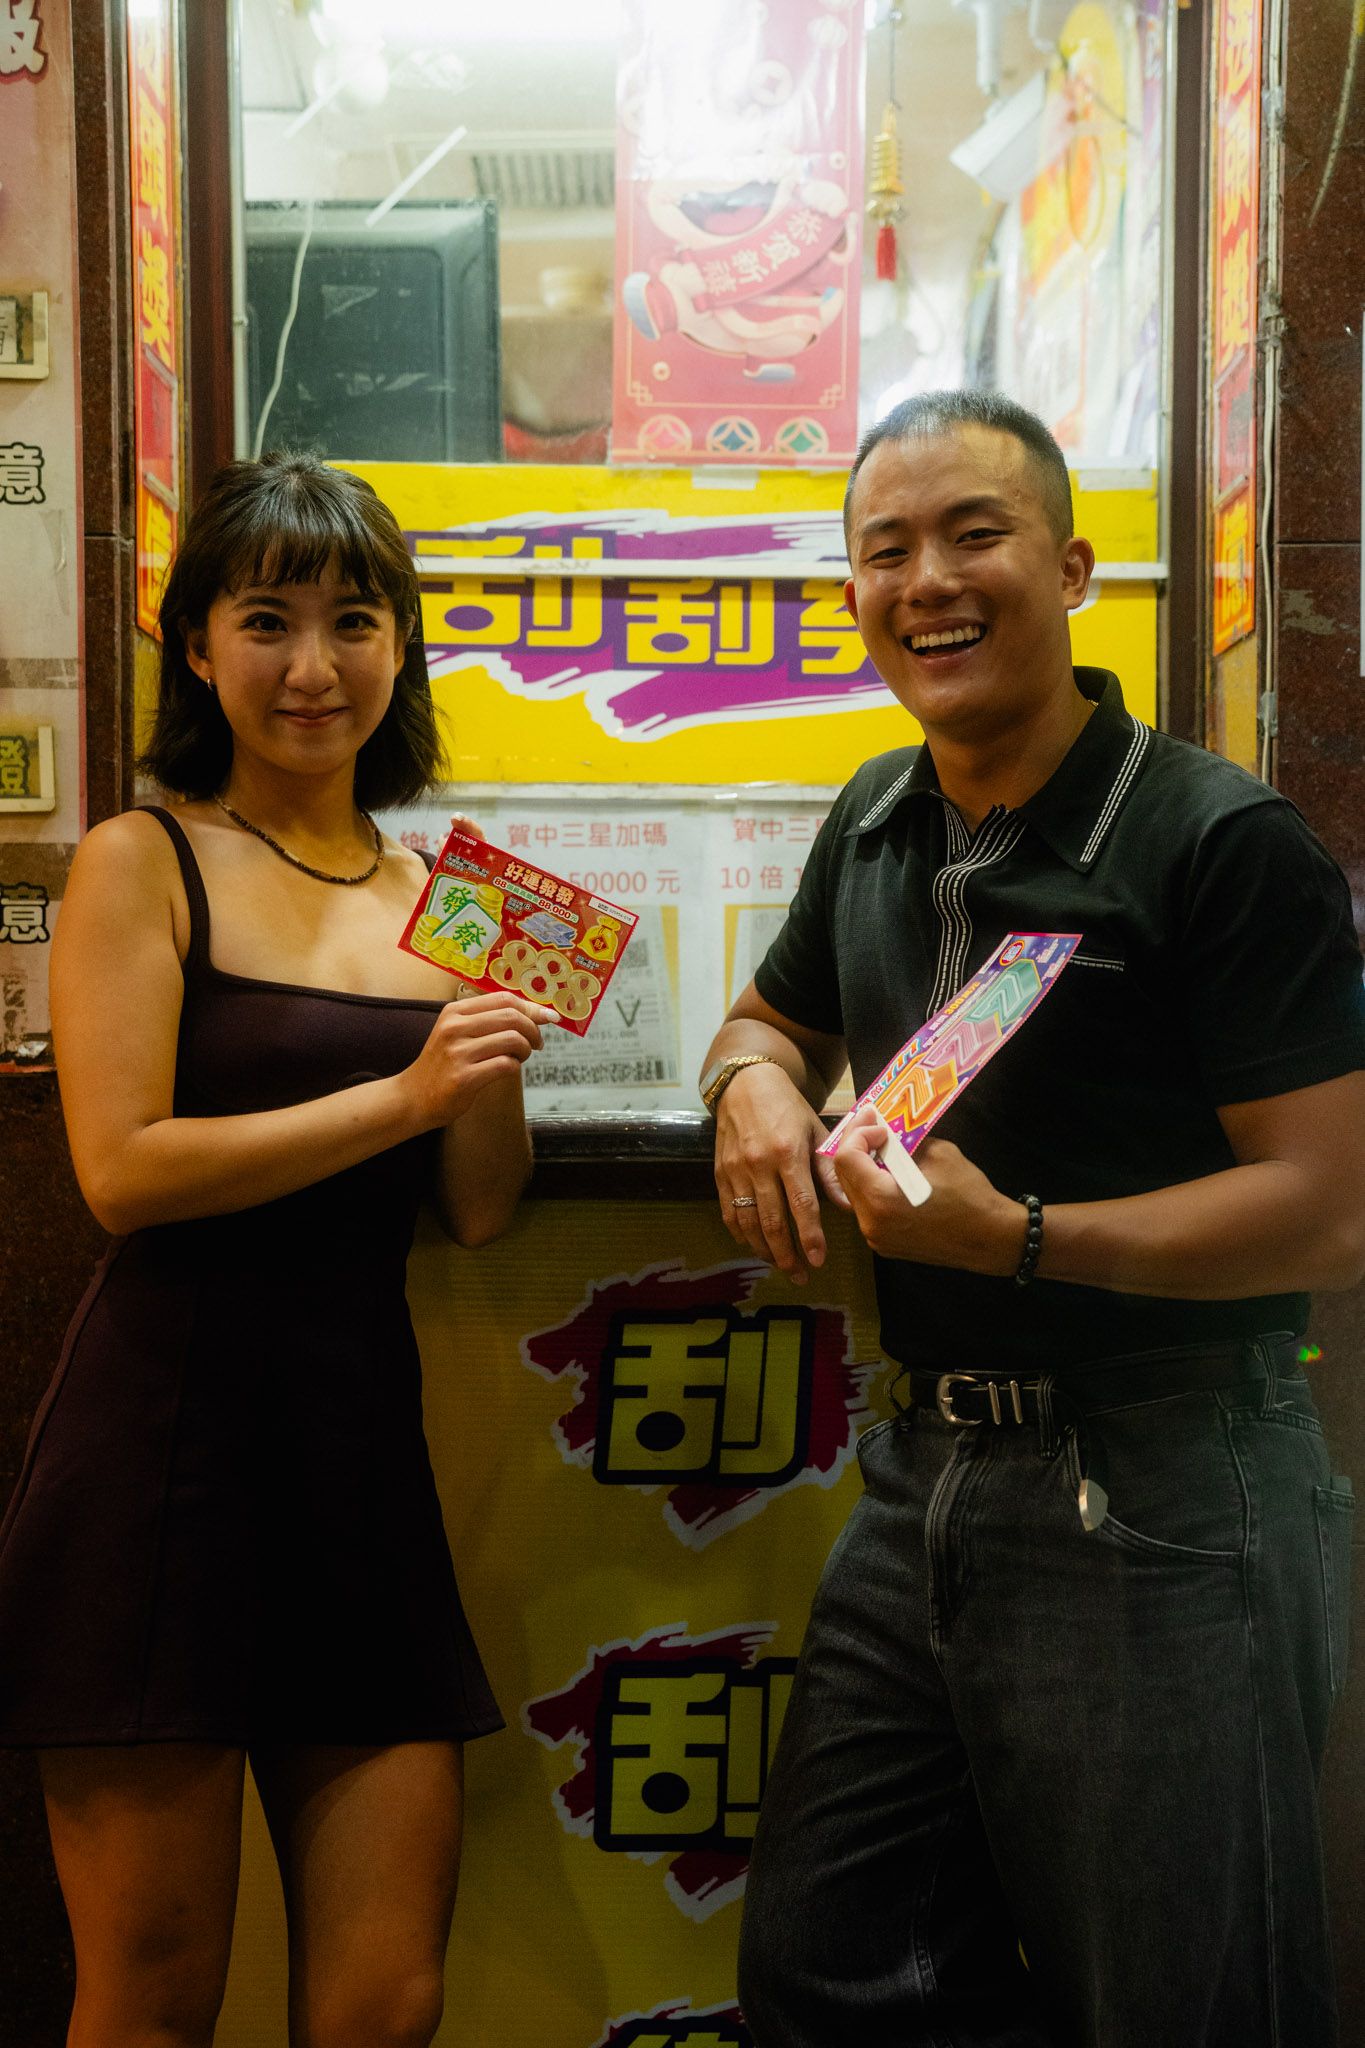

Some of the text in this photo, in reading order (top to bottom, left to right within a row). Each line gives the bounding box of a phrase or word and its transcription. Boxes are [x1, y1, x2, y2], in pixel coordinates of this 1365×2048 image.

[507, 822, 669, 848] 賀中三星加碼
[503, 861, 577, 907] 好運發發
[656, 869, 681, 894] 元
[721, 867, 751, 889] 10
[760, 864, 784, 890] 倍
[452, 919, 487, 953] 發
